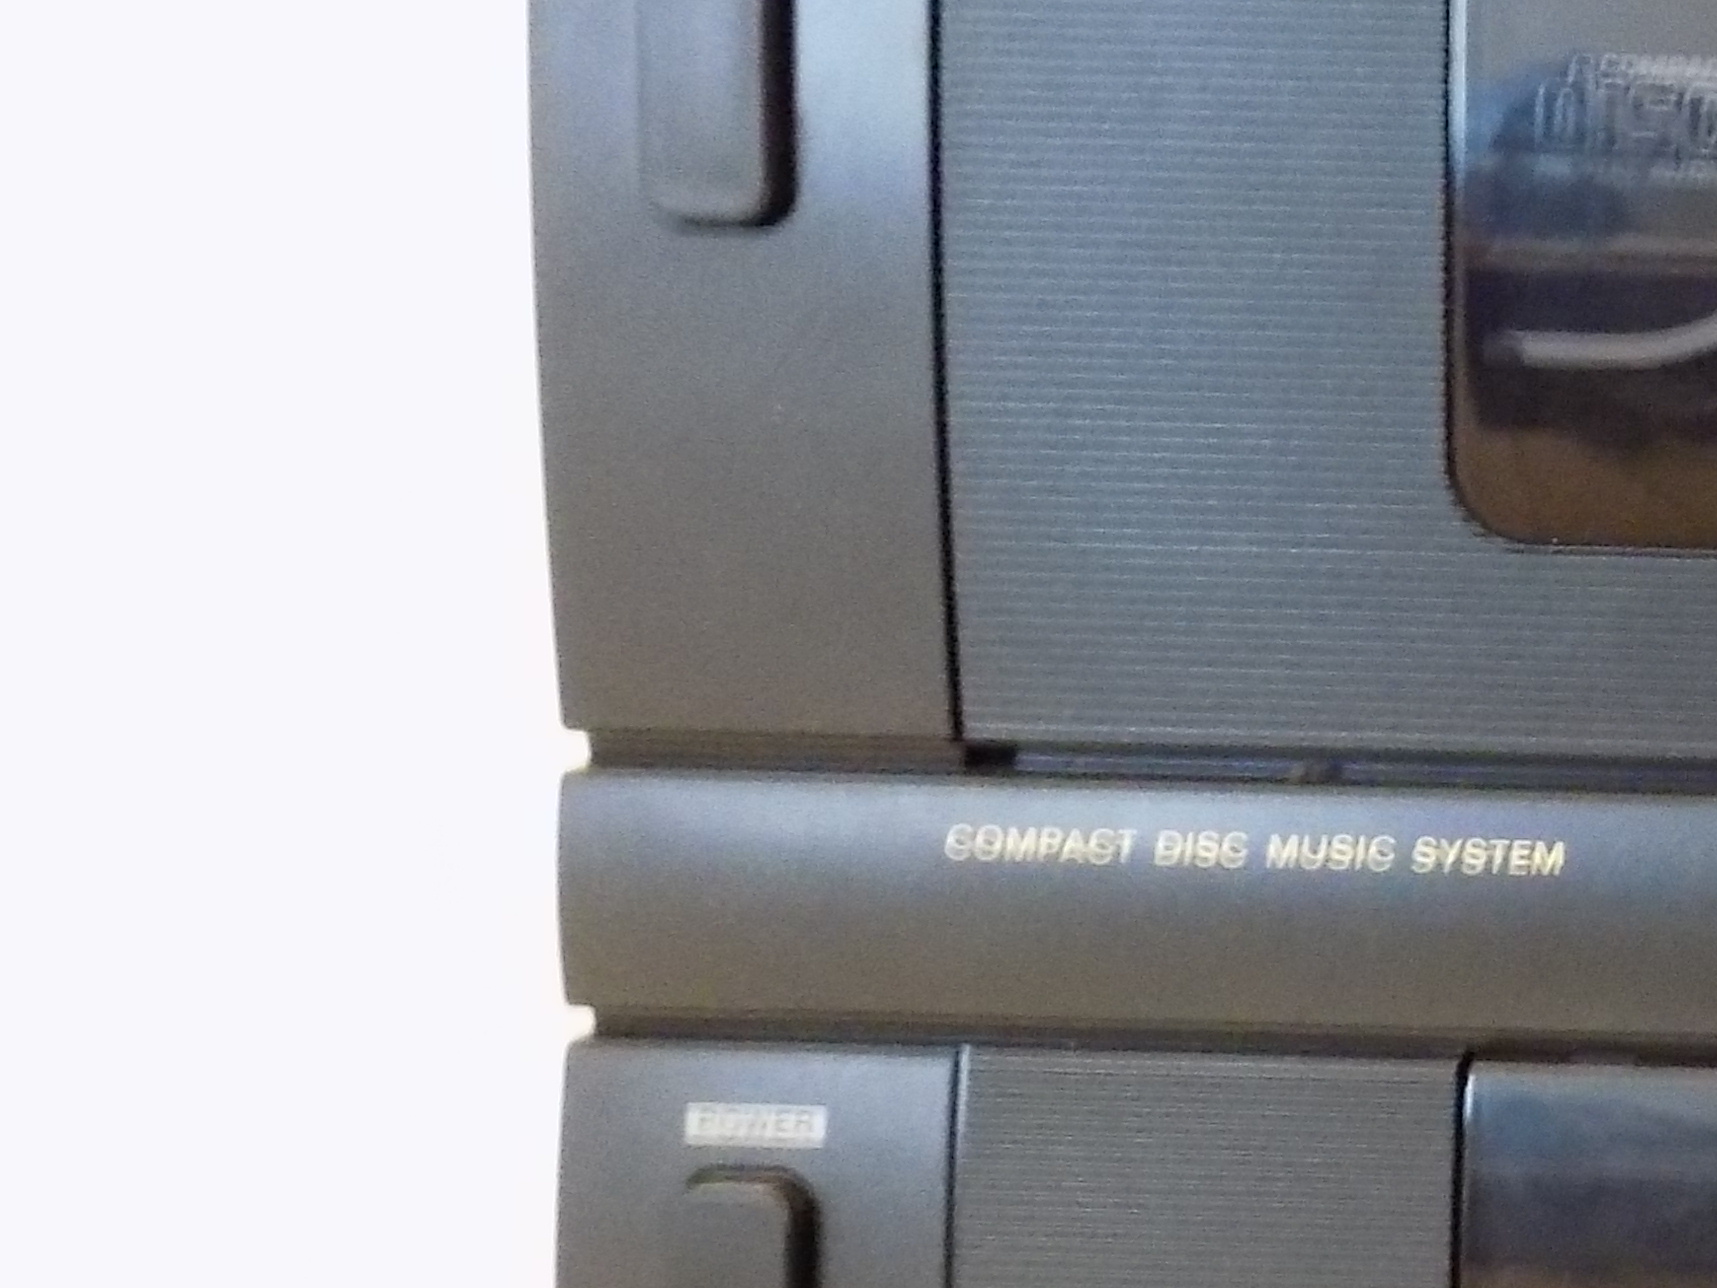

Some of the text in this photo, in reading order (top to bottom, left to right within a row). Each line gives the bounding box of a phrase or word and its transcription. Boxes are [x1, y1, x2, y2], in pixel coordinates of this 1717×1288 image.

[944, 823, 1566, 876] COMPACT DISC MUSIC SYSTEM
